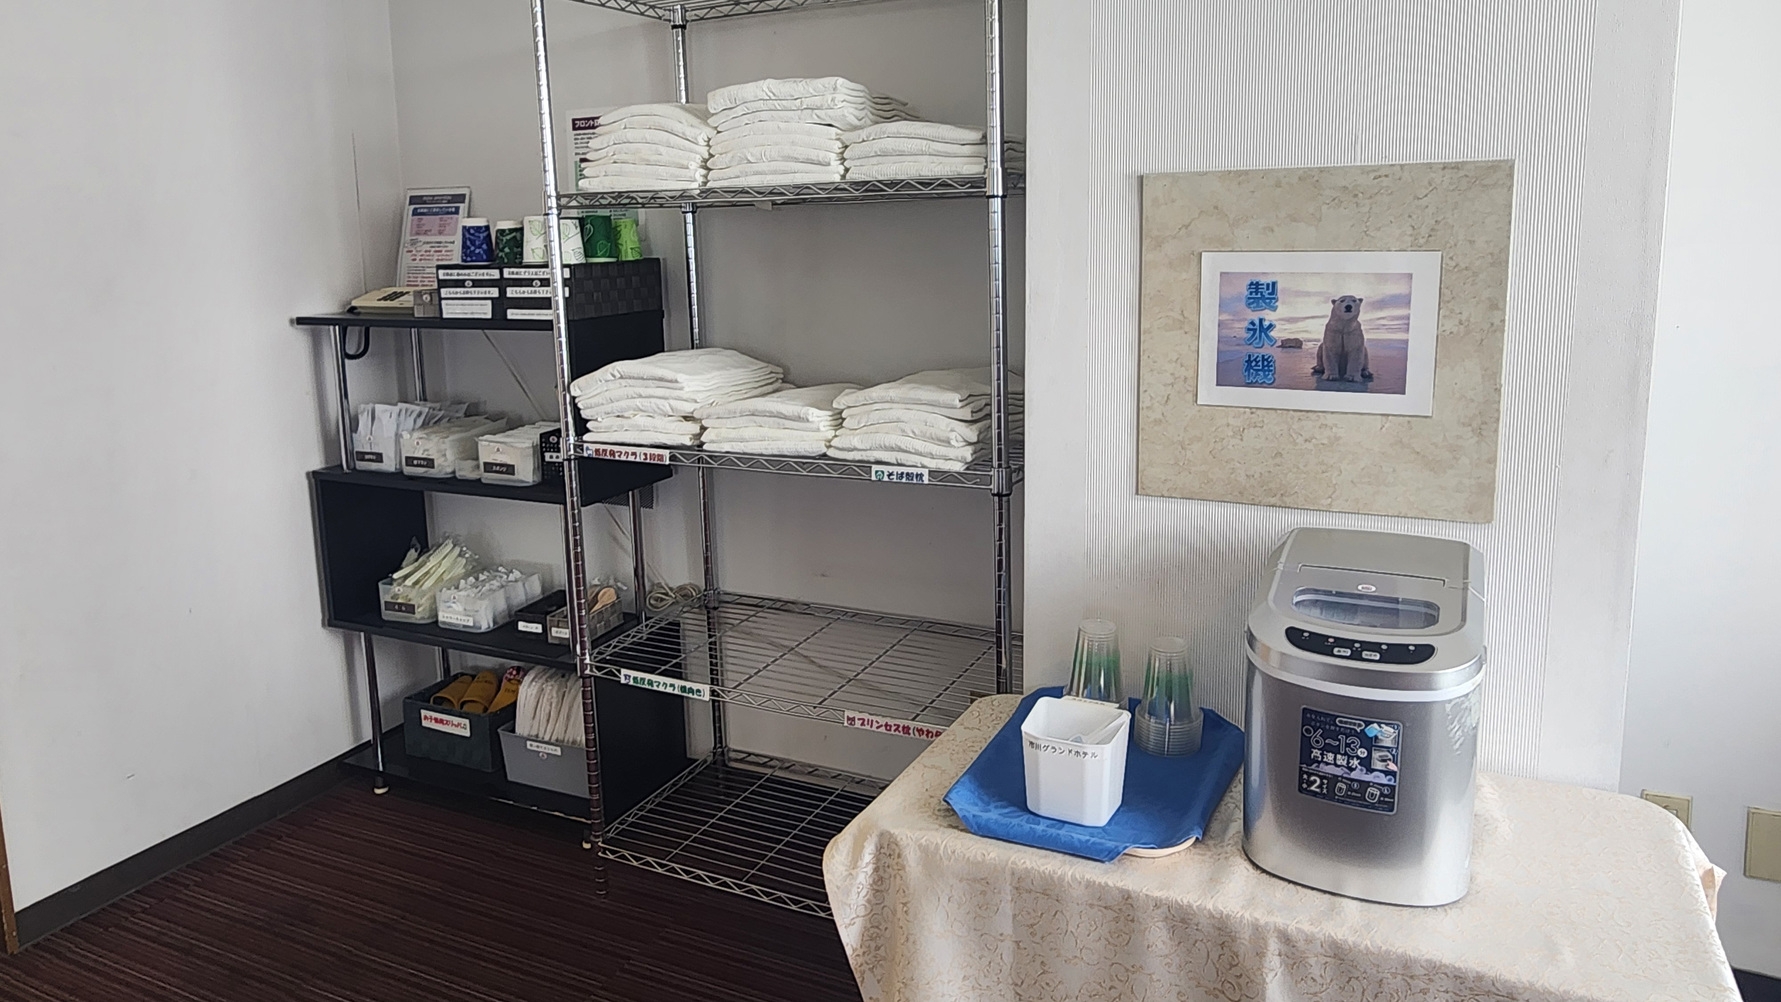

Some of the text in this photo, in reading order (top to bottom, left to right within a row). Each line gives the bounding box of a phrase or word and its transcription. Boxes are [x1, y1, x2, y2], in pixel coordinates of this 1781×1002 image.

[1243, 279, 1279, 386] 製氷機
[886, 470, 925, 483] そば殻枕
[1309, 776, 1321, 793] 2
